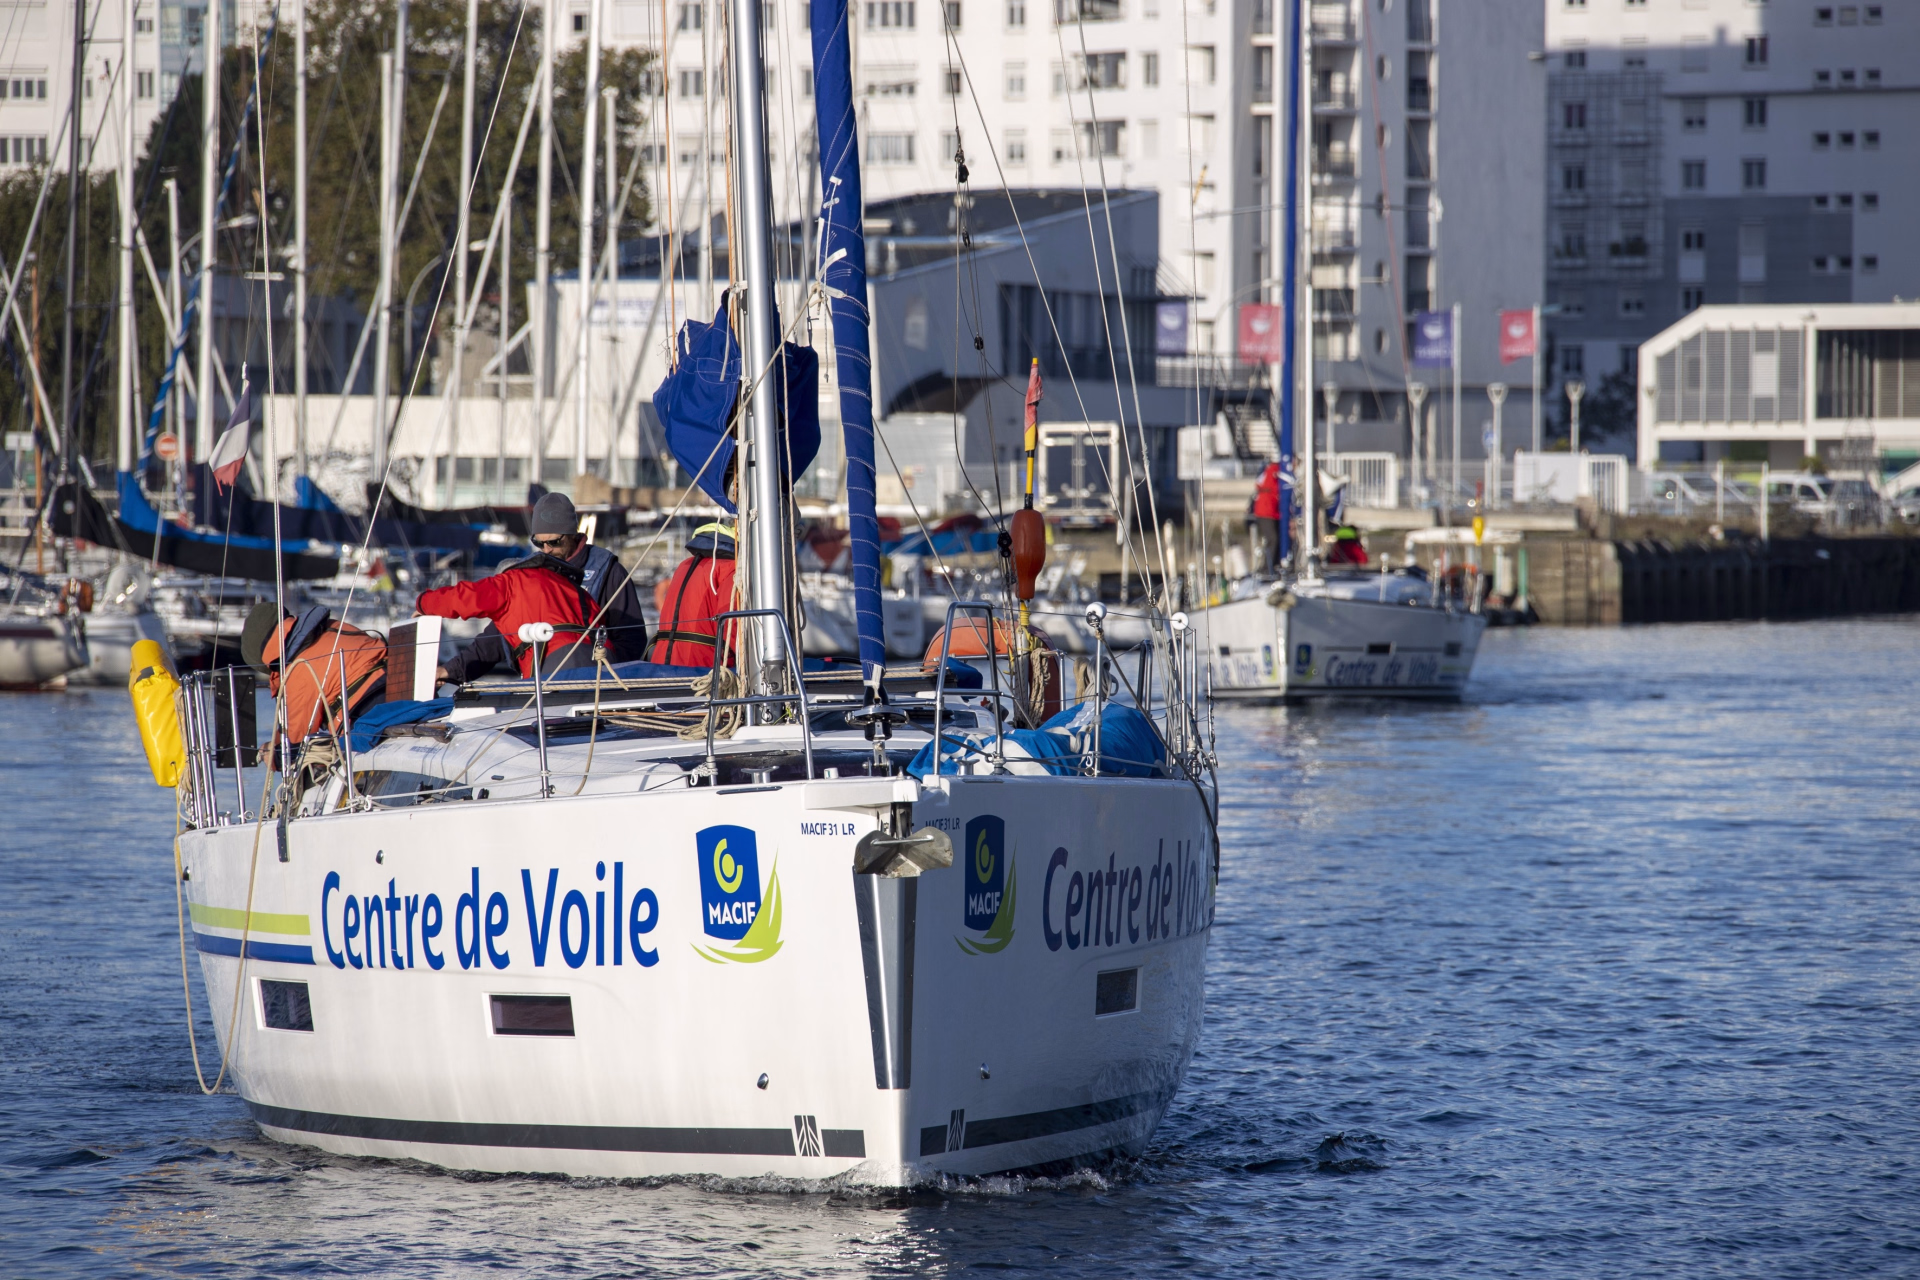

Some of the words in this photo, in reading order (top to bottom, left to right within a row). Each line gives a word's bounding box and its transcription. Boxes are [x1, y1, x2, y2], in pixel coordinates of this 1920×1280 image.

[842, 823, 856, 836] LR
[952, 817, 960, 830] LR
[968, 891, 1001, 916] MACIF
[1043, 846, 1142, 952] Centre
[1147, 838, 1173, 942] de
[321, 870, 445, 970] Centre
[455, 866, 511, 970] de
[520, 860, 660, 968] Voile
[708, 901, 756, 925] MACIF
